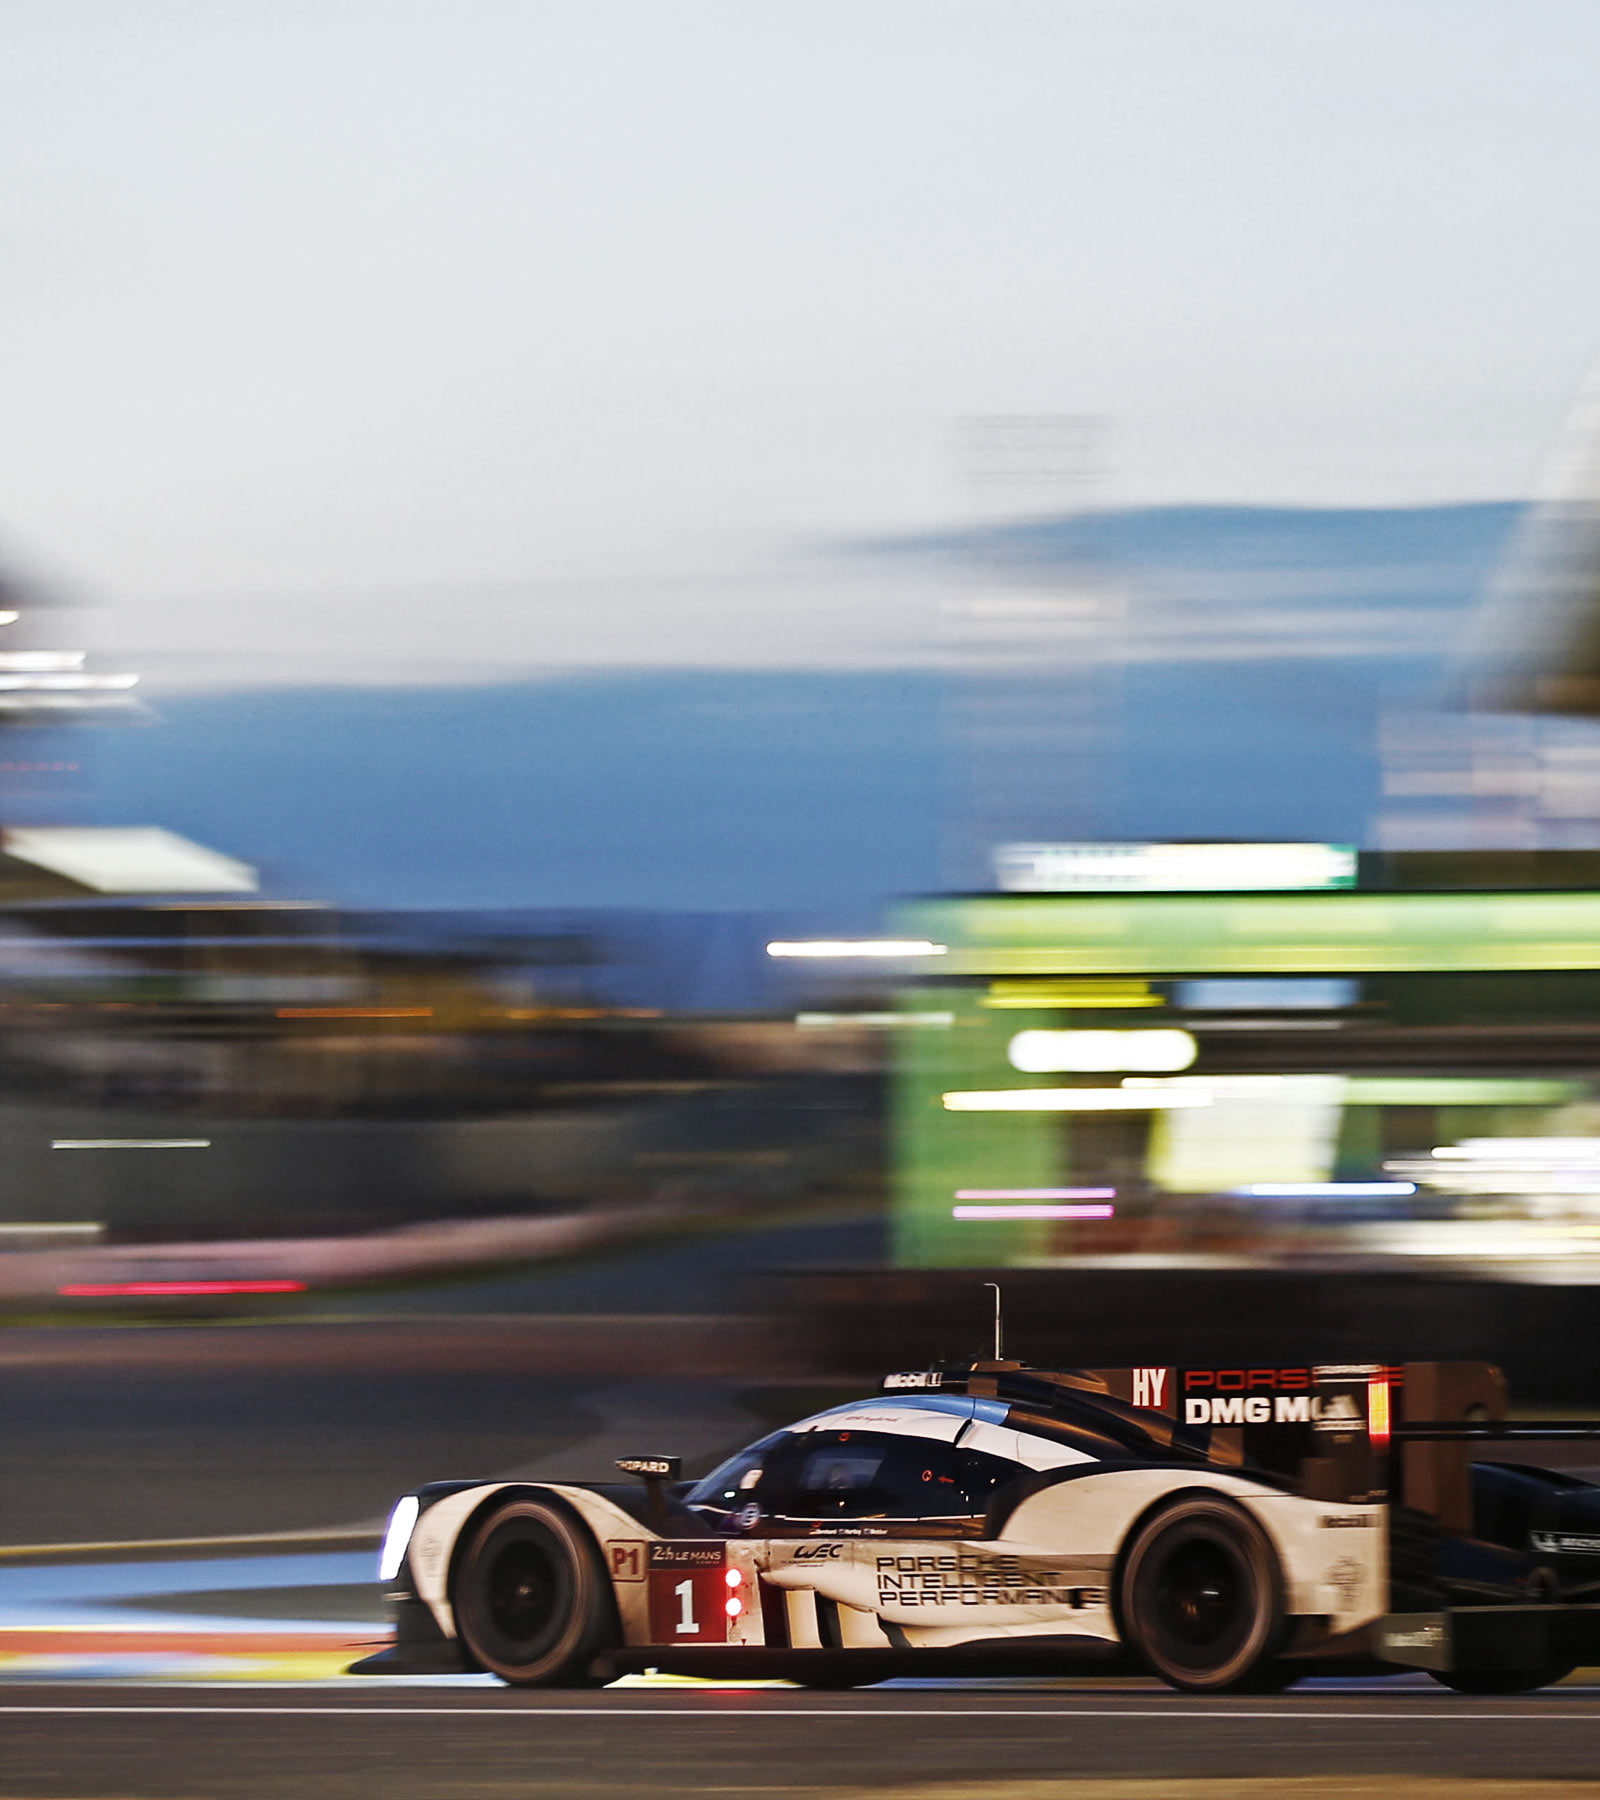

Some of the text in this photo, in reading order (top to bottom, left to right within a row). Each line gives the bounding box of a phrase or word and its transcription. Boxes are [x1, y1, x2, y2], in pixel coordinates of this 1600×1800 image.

[1133, 1368, 1166, 1406] HY
[1185, 1367, 1404, 1391] PORSE
[1185, 1397, 1271, 1425] DMG
[612, 1547, 638, 1575] P1
[675, 1551, 689, 1560] LE
[690, 1551, 721, 1560] MANS
[793, 1543, 843, 1559] WEC
[876, 1554, 1019, 1572] PORSCHE
[675, 1579, 700, 1634] 1
